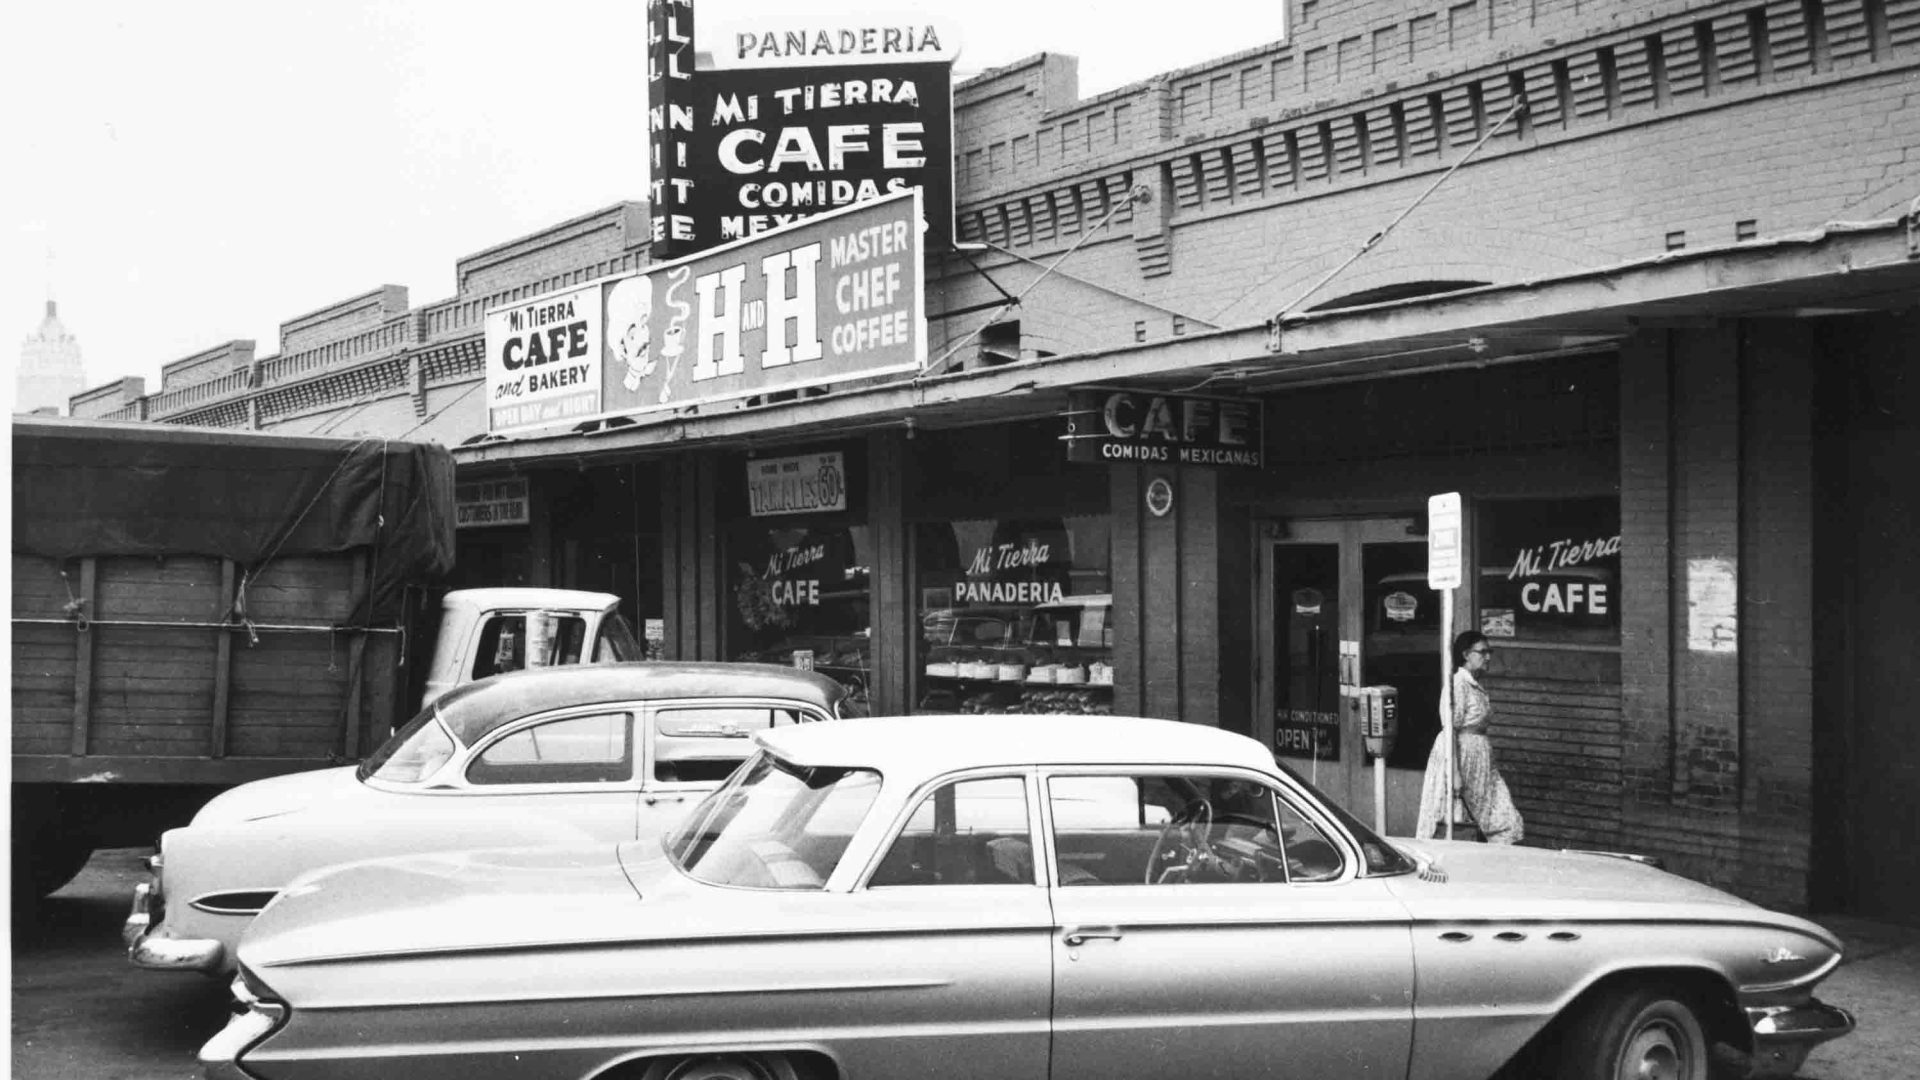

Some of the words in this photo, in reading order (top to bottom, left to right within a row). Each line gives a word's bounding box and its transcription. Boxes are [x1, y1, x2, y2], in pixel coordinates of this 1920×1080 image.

[648, 0, 663, 82] LL
[667, 0, 692, 80] LL
[711, 91, 759, 127] MI
[774, 78, 919, 115] TIERRA
[717, 122, 927, 174] CAFE
[669, 103, 696, 241] NITE
[831, 219, 908, 268] MASTER
[836, 262, 900, 314] CHEF
[741, 299, 765, 332] AND
[832, 310, 908, 355] COFFEE
[502, 320, 588, 371] CAFE
[495, 374, 525, 400] and
[529, 363, 590, 393] BAKERY
[1104, 393, 1249, 444] CAFE
[1102, 443, 1168, 461] COMIDAS
[1179, 447, 1259, 466] MEXICANAS
[762, 552, 783, 580] Mi
[966, 547, 993, 575] Mi
[997, 541, 1050, 569] Tierra
[1507, 545, 1544, 580] Mi
[1548, 535, 1621, 571] Tierra
[772, 580, 819, 605] CAFE
[955, 581, 1064, 603] PANADERIA
[1522, 582, 1607, 614] CAFE
[1276, 727, 1310, 750] OPEN
